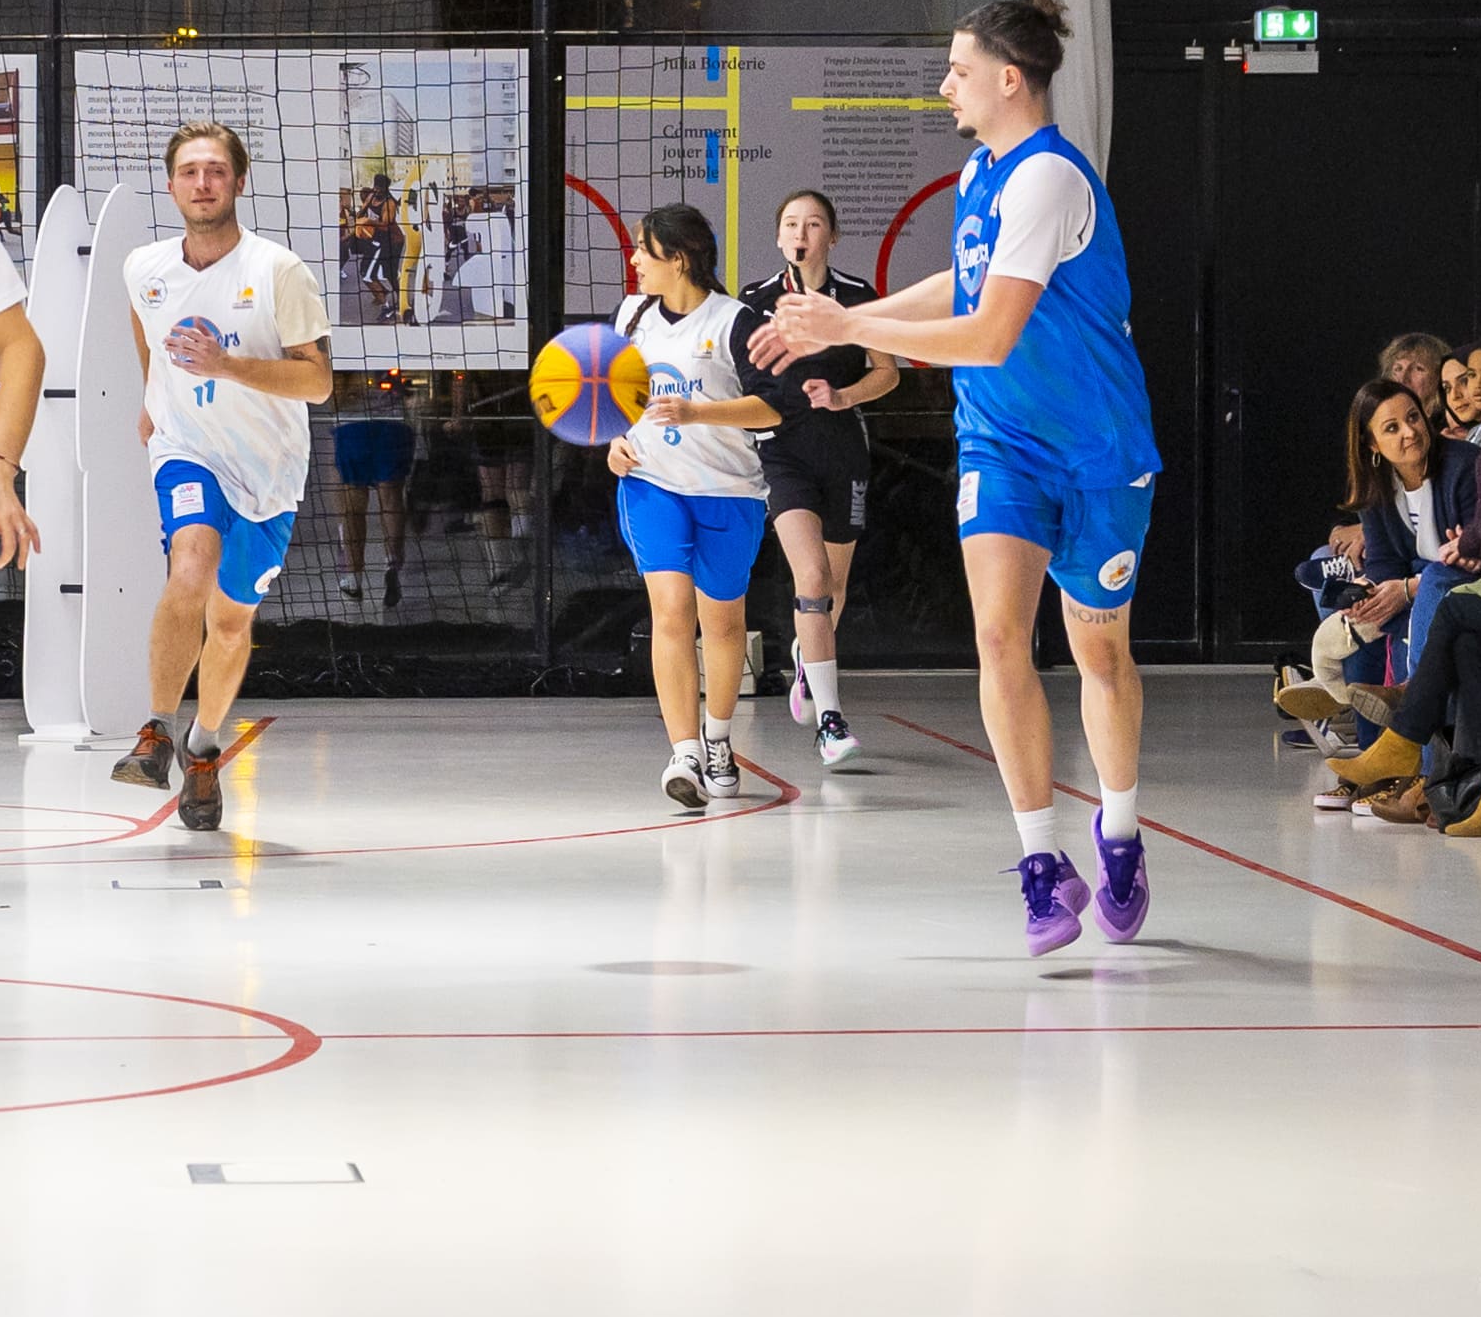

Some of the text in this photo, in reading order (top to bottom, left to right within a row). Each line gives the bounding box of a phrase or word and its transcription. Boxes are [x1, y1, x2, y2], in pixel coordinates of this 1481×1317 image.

[663, 56, 766, 72] Juia Borderie
[139, 96, 176, 104] sulpture
[662, 125, 738, 139] Comment
[662, 145, 702, 161] jouer
[718, 145, 773, 162] Tripple
[663, 165, 719, 180] Dribble
[193, 379, 216, 408] 11
[849, 479, 869, 529] NIKE
